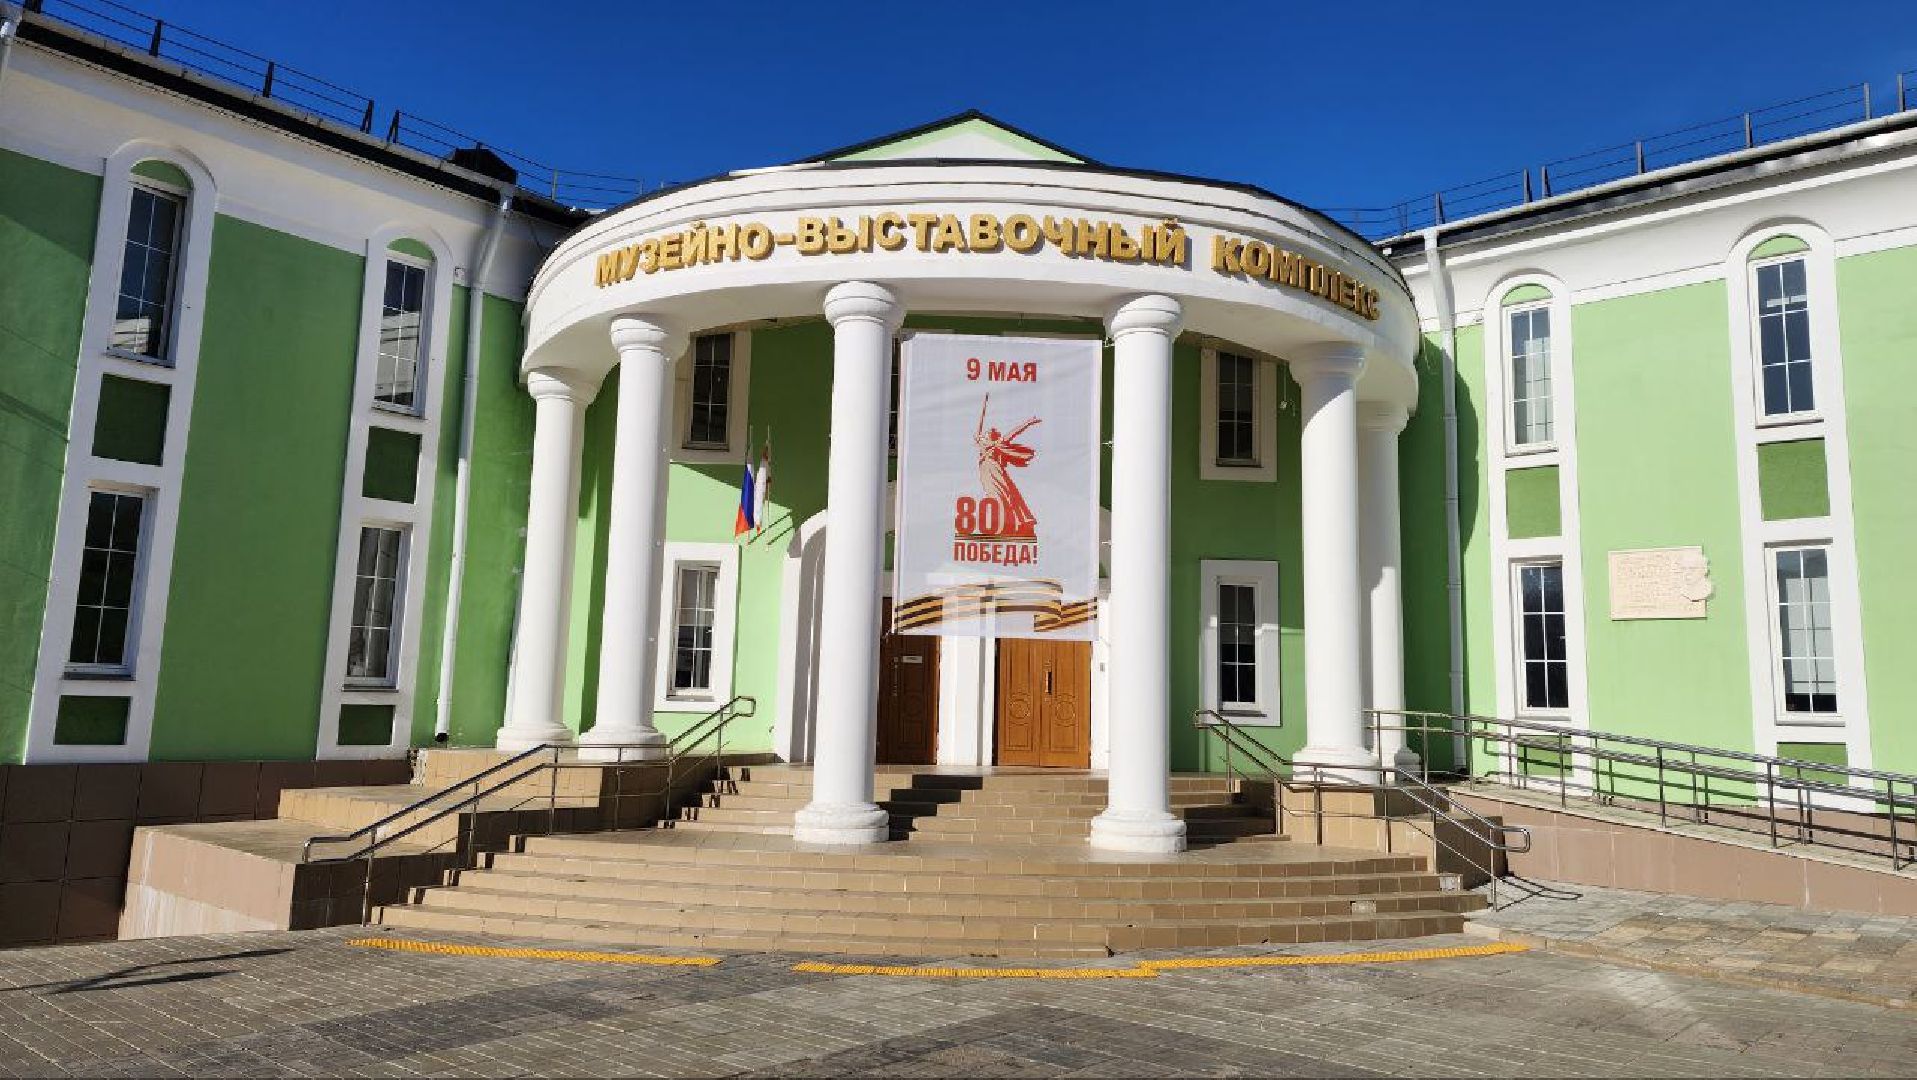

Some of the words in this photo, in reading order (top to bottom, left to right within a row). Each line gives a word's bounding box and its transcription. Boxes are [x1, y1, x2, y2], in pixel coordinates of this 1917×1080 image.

[594, 211, 1187, 288] МУЗЕЙНО-ВЫСТАВОЧНЫЙ
[1212, 234, 1380, 320] КОМПЛЕКС
[966, 358, 981, 381] 9
[988, 361, 1038, 383] МАЯ
[955, 496, 999, 535] 80
[953, 541, 1039, 566] ПОБЕДА!
